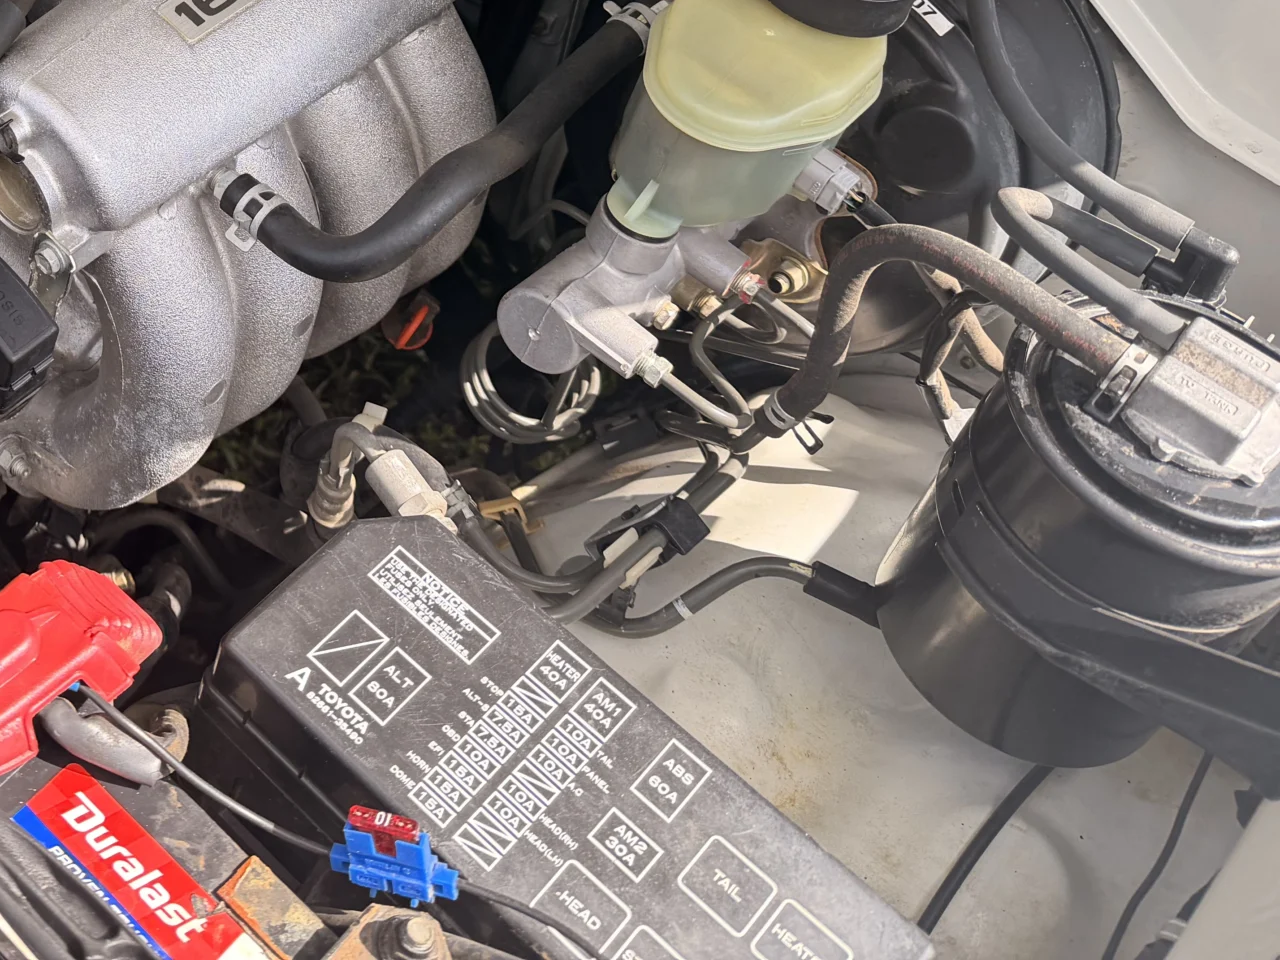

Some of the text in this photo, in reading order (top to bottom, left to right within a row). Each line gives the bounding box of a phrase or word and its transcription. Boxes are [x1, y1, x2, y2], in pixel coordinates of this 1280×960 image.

[385, 563, 413, 587] FUSES
[379, 568, 463, 640] UTILISEZ SEULEMENT
[390, 589, 430, 623] FUSIBLES
[421, 572, 470, 616] NOTICE
[425, 589, 474, 632] DESIGNATED
[284, 667, 312, 691] A
[383, 665, 415, 689] ALT
[539, 665, 568, 690] 40A
[545, 651, 582, 683] HEATER
[367, 680, 395, 708] 80A
[480, 676, 505, 697] STOP
[320, 683, 370, 735] TOYOTA
[457, 710, 476, 727] STA
[507, 697, 533, 725] 15A
[583, 703, 612, 729] 40A
[592, 692, 622, 717] AM1
[441, 724, 461, 743] OBD
[493, 712, 521, 741] 7.5A
[565, 723, 591, 750] 10A
[427, 740, 446, 757] EFI
[478, 726, 508, 757] 7.5A
[552, 738, 577, 765] 10A
[406, 750, 431, 774] HORN
[462, 743, 490, 771] 10A
[537, 752, 563, 782] 10A
[596, 749, 614, 769] TAIL
[389, 764, 416, 790] DOME
[448, 759, 476, 788] 15A
[581, 765, 611, 794] PANEL
[662, 758, 694, 786] ABS
[433, 774, 460, 803] 15A
[508, 783, 535, 812] 10A
[648, 775, 678, 804] 60A
[417, 791, 445, 820] 15A
[493, 799, 520, 828] 10A
[539, 813, 578, 850] HEAD(RH)
[613, 824, 648, 855] AM2
[524, 829, 564, 867] HEAD(LH)
[605, 836, 636, 866] 30A
[60, 790, 209, 944] Duralast
[712, 868, 743, 903] TAIL
[558, 890, 602, 931] HEAD
[771, 923, 821, 960] HEAT
